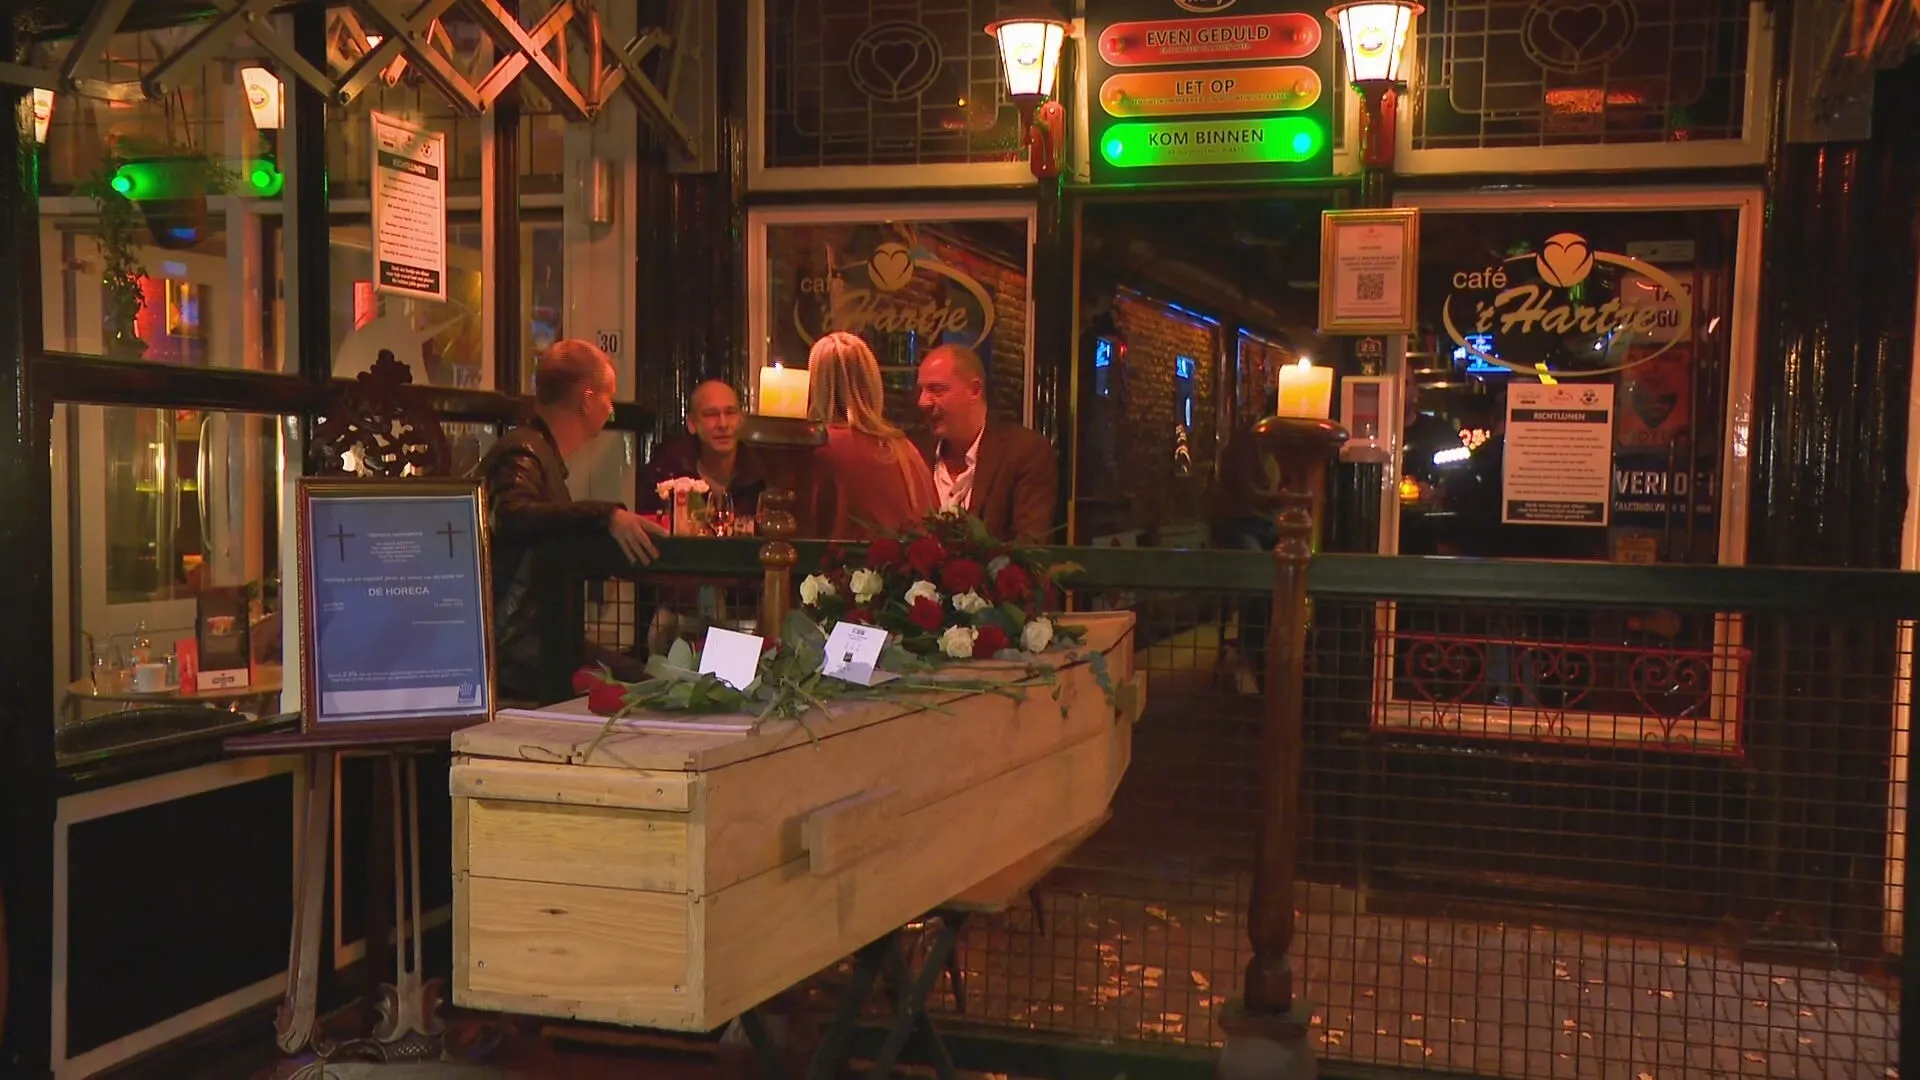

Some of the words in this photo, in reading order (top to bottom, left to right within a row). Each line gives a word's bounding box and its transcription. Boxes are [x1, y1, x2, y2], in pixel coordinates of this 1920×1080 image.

[1147, 30, 1191, 46] EVEN
[1198, 26, 1270, 43] GEDULD
[1176, 80, 1204, 95] LET
[1211, 79, 1235, 93] OP
[1149, 132, 1189, 146] KOM
[1196, 129, 1264, 144] BINNEN
[1453, 266, 1507, 289] café
[600, 333, 618, 354] 30
[368, 588, 383, 597] DE
[385, 586, 430, 597] HORECA
